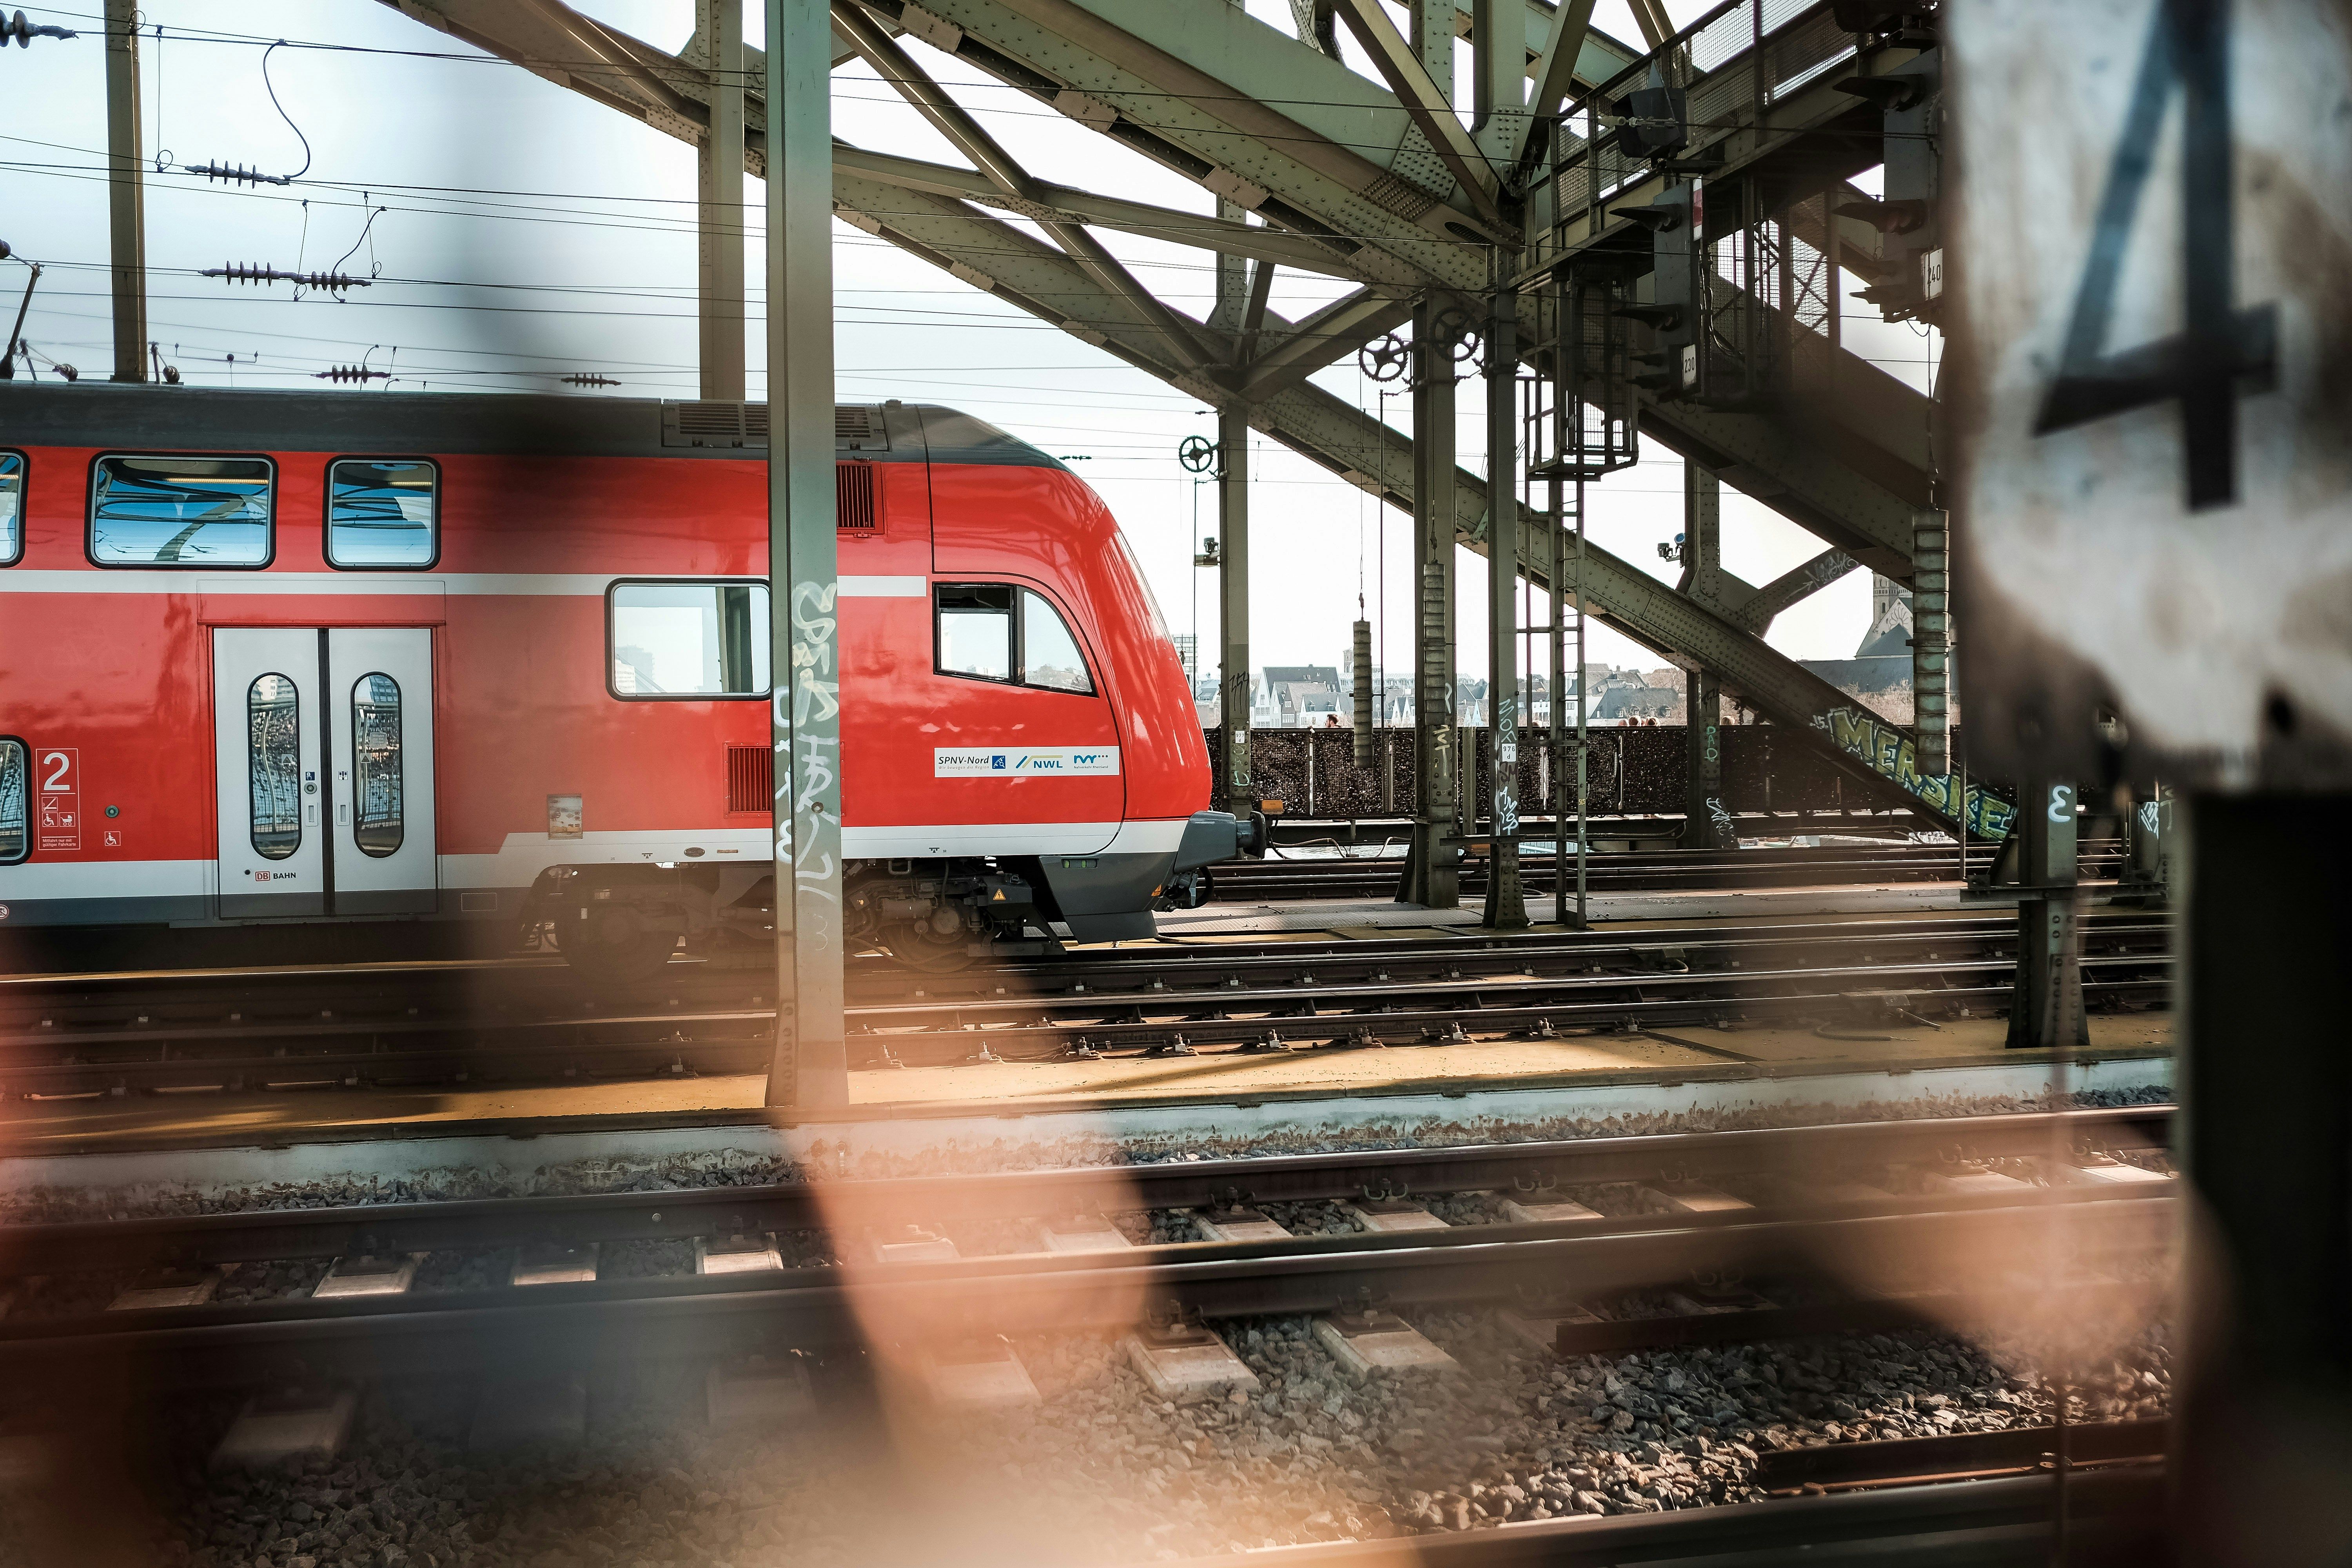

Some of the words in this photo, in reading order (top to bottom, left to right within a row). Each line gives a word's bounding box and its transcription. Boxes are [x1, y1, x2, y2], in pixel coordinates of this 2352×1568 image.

[2034, 0, 2279, 513] 4
[1927, 264, 1940, 285] 240
[1685, 357, 1695, 372] 230
[938, 755, 989, 764] SPNV-Nord
[44, 752, 70, 790] 2
